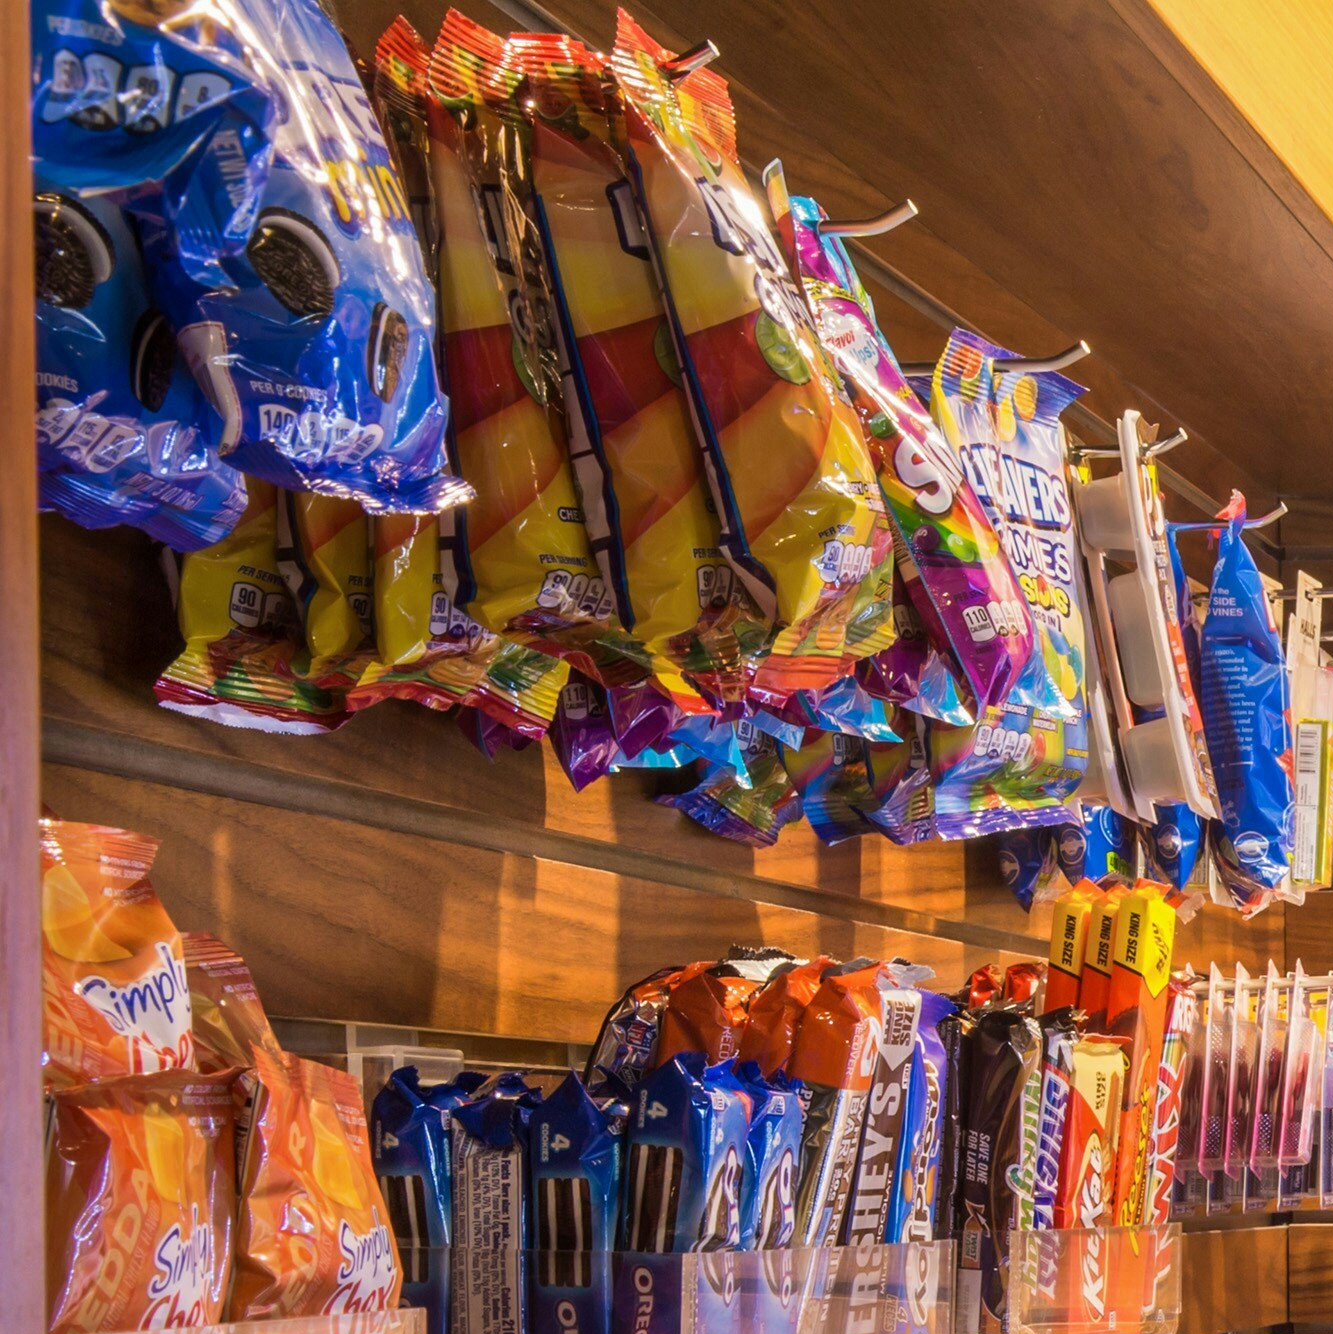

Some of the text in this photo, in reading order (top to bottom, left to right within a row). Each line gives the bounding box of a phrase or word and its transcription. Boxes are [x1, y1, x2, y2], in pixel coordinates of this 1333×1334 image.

[237, 586, 256, 609] 90
[433, 595, 446, 615] 90
[965, 607, 988, 627] 110
[1300, 618, 1317, 640] HALLS
[1062, 914, 1077, 967] KING SIZE
[1097, 914, 1113, 967] KING SIZE
[1125, 911, 1141, 964] KING SIZE
[889, 999, 904, 1047] KING
[900, 1000, 917, 1047] SIZE
[639, 1089, 647, 1129] COOKIES
[651, 1101, 668, 1119] 4
[382, 1133, 399, 1150] 4
[540, 1122, 549, 1163] COOKIES
[550, 1133, 571, 1152] 4
[965, 1129, 978, 1183] FOR LATER
[977, 1132, 991, 1186] SAVE ONE
[152, 1204, 208, 1294] Simply
[339, 1206, 395, 1279] Simply
[501, 1288, 511, 1318] Calories
